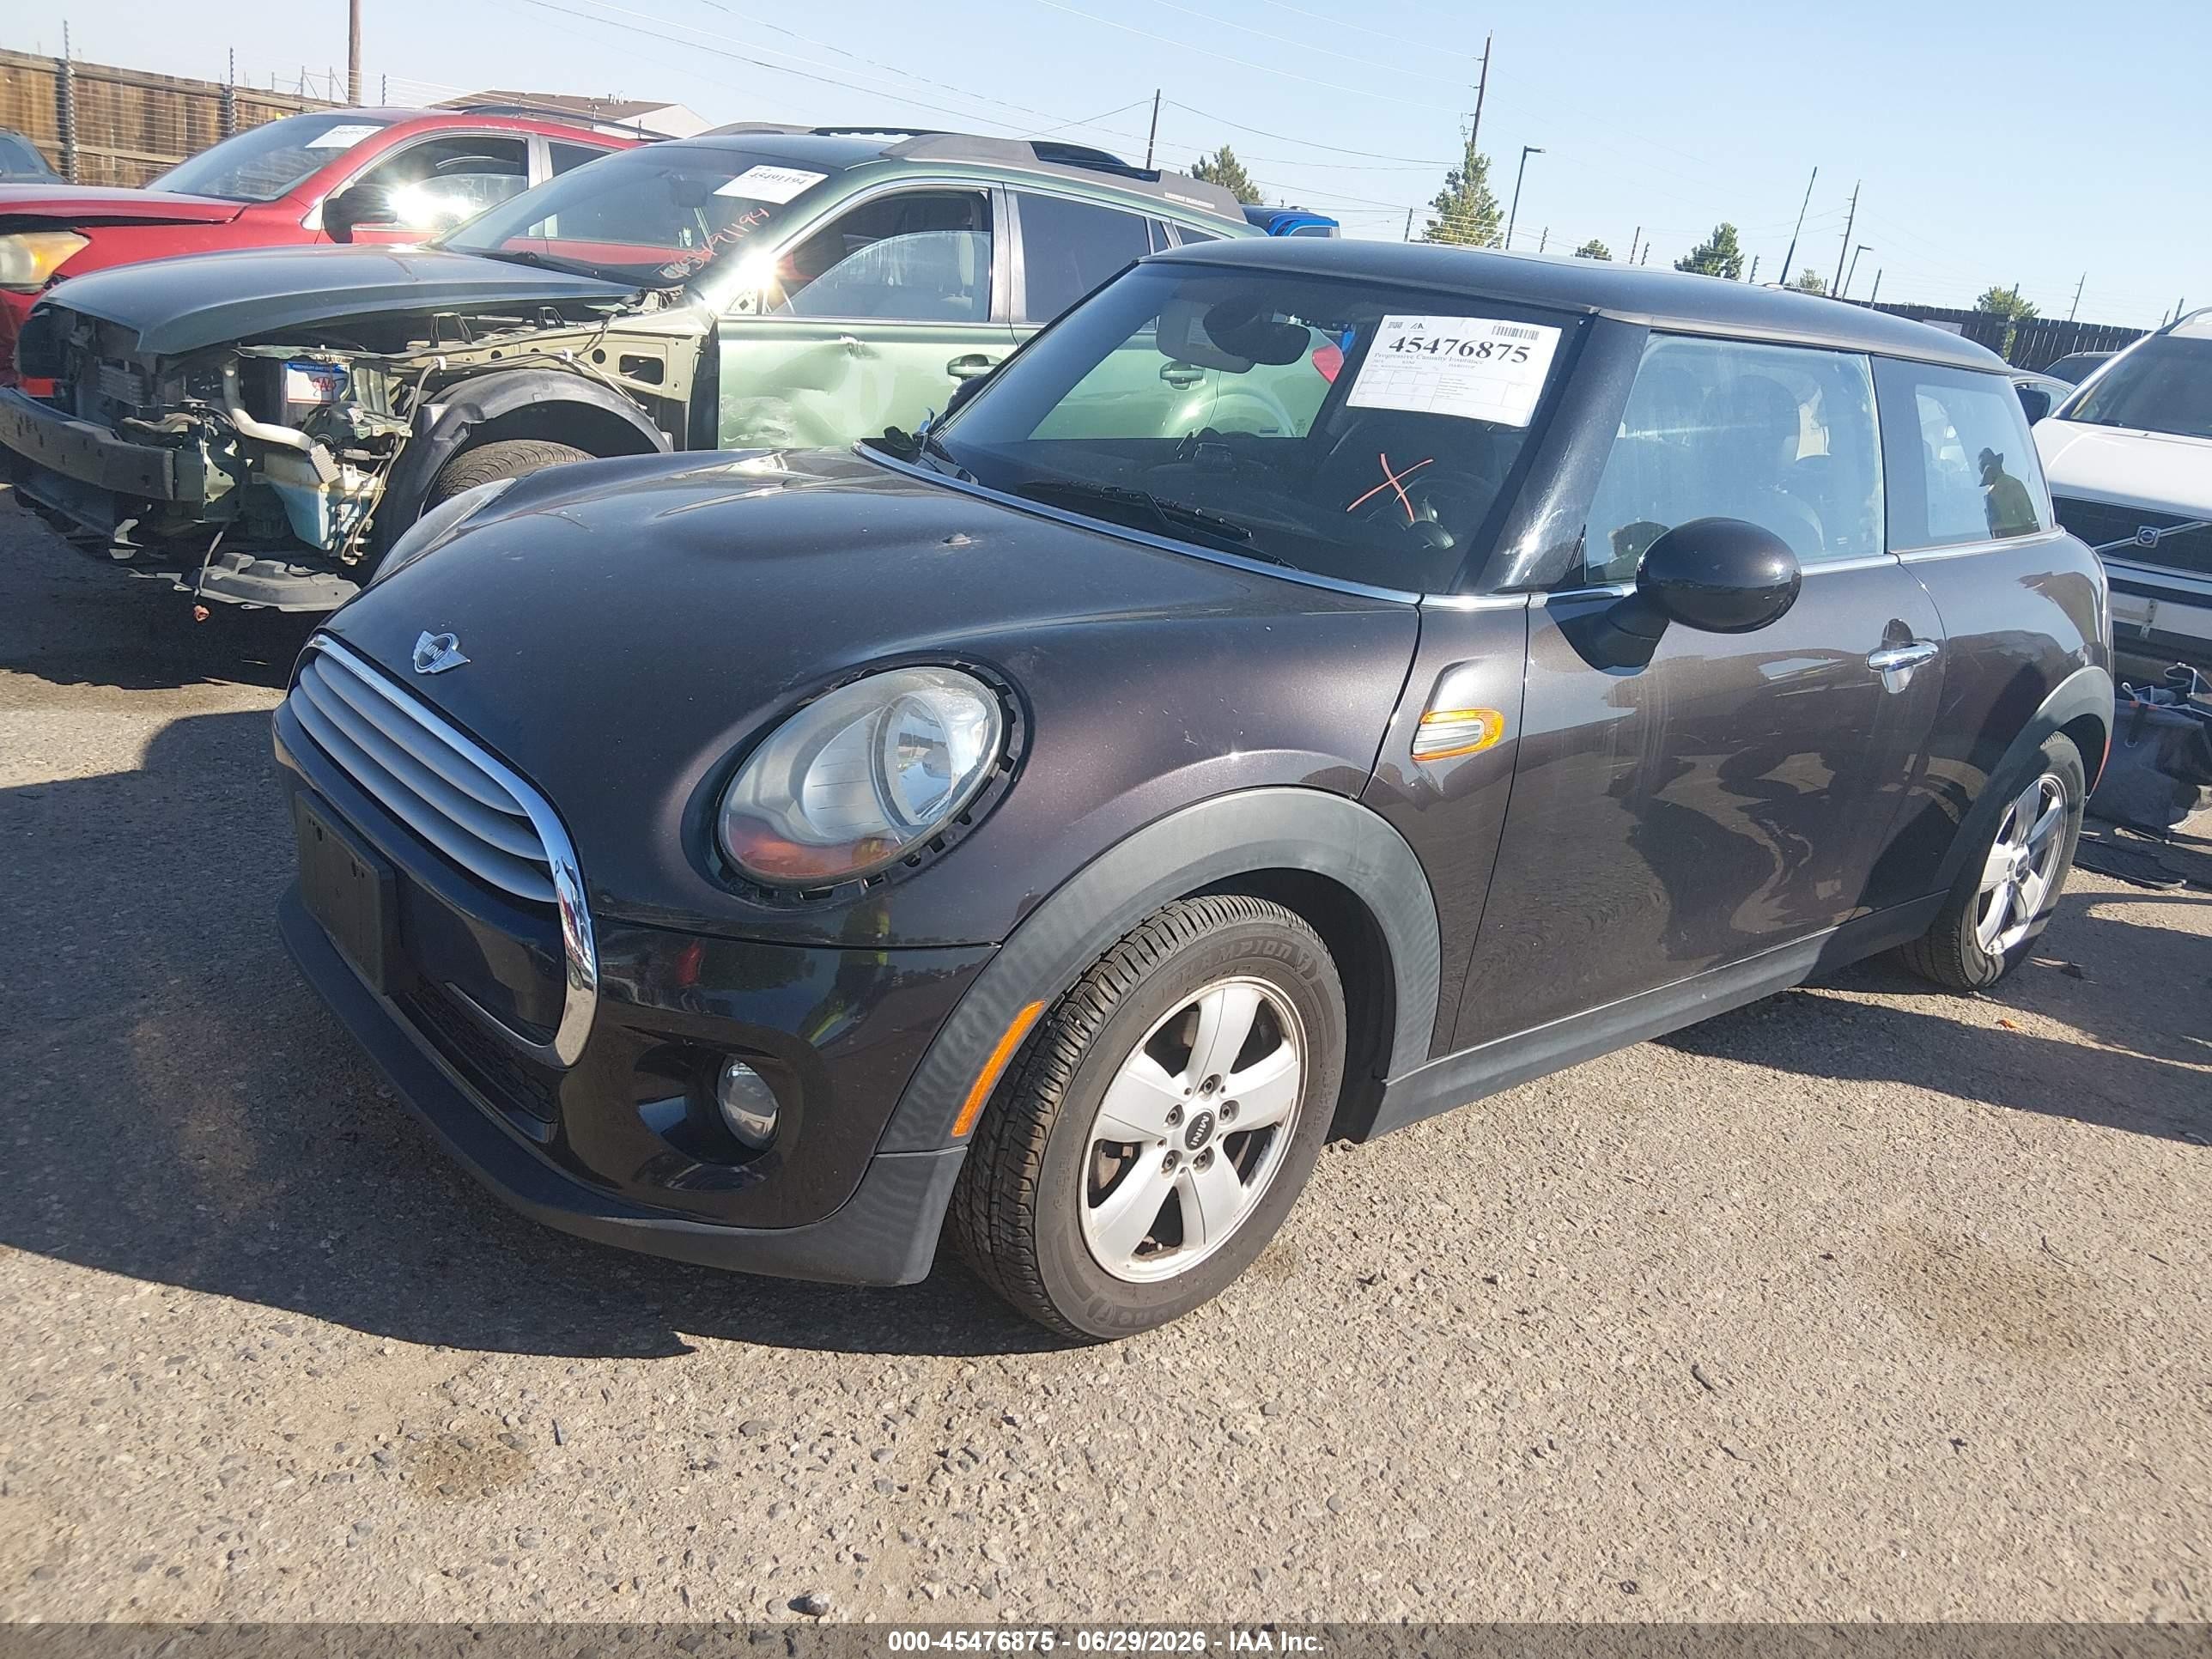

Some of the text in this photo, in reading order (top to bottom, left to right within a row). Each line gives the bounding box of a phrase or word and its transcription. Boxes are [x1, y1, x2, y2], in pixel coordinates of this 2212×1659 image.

[1374, 352, 1415, 361] Progressive
[1389, 336, 1531, 363] 45476875
[1190, 1115, 1210, 1146] MINI
